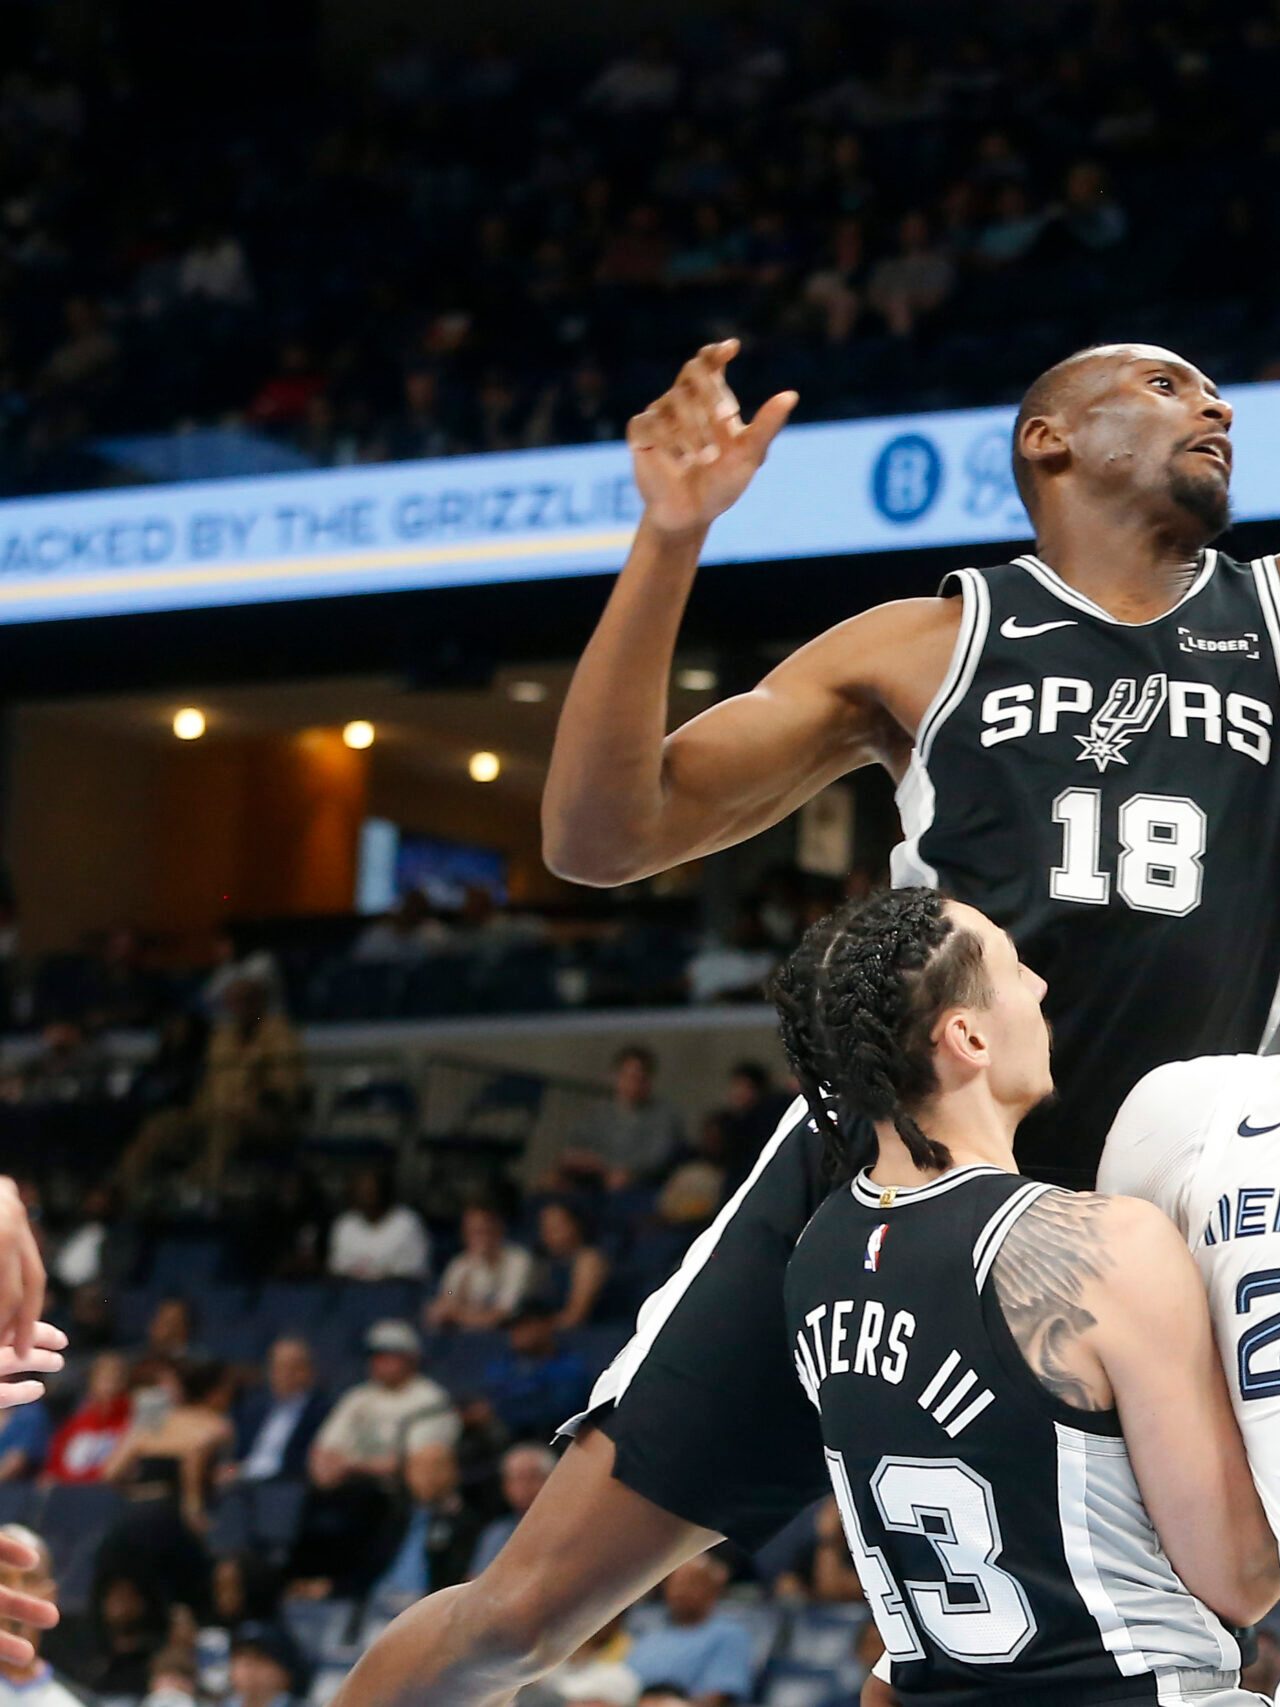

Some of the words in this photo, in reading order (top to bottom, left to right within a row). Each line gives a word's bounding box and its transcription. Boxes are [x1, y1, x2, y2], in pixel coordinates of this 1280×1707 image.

[188, 510, 259, 557] BY
[273, 498, 378, 546] THE
[1187, 636, 1250, 652] LEDGER
[980, 673, 1273, 767] SPURS
[1049, 786, 1207, 918] 18
[917, 1348, 996, 1439] III
